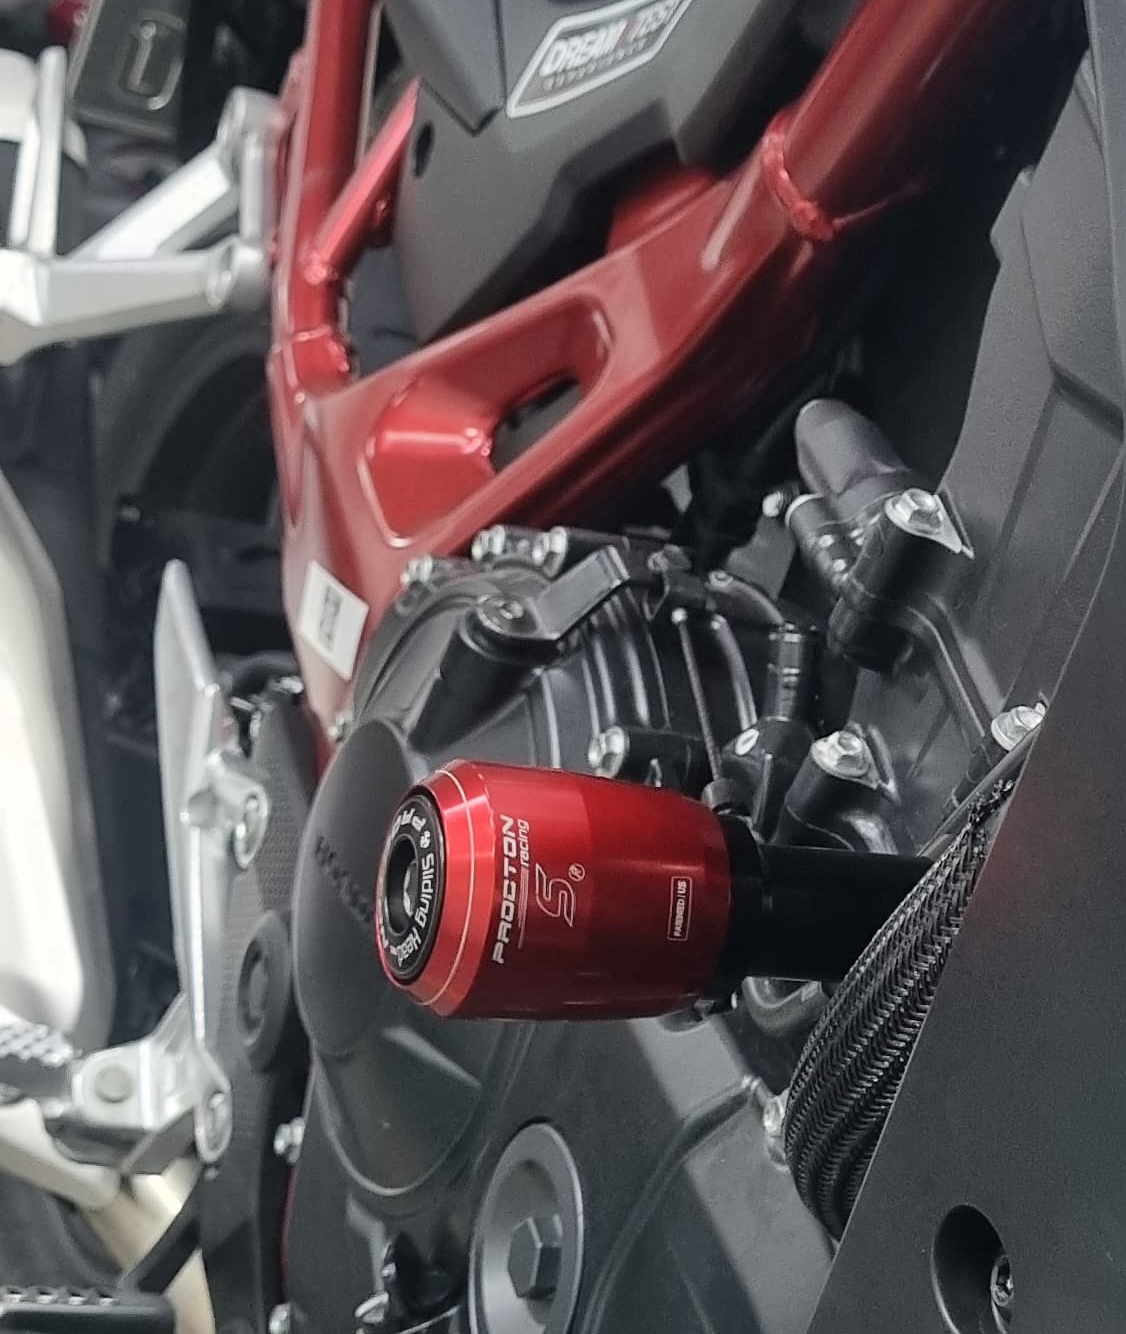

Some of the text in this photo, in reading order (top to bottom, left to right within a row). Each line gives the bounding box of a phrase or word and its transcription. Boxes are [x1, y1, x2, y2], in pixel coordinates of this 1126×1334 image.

[517, 818, 530, 868] racing
[413, 851, 436, 930] Sliding
[492, 814, 517, 964] PROCTON
[397, 927, 423, 967] Head
